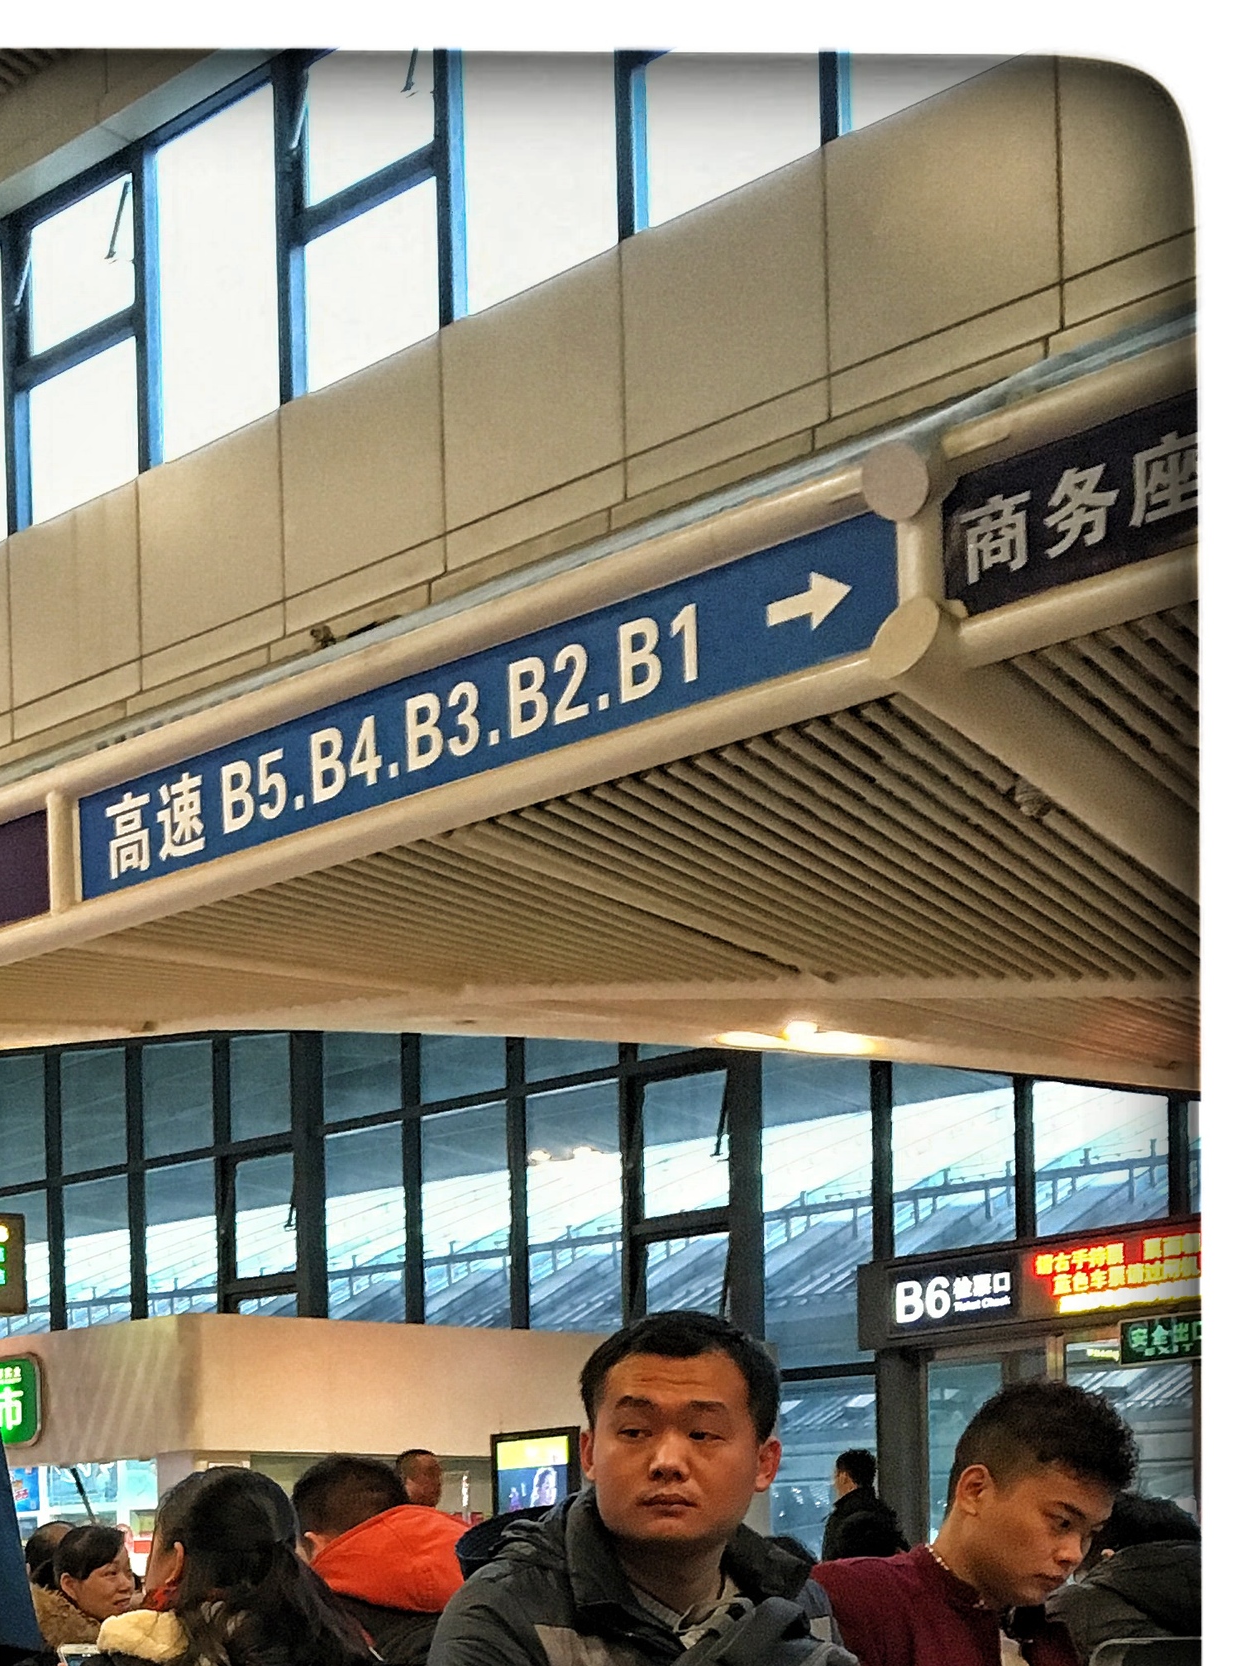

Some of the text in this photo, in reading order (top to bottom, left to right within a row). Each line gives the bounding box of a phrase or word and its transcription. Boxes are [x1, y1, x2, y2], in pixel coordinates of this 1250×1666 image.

[959, 432, 1199, 585] 商务座
[105, 603, 700, 881] 高速 B5.B4.B3.B2.B1
[895, 1276, 952, 1325] B6
